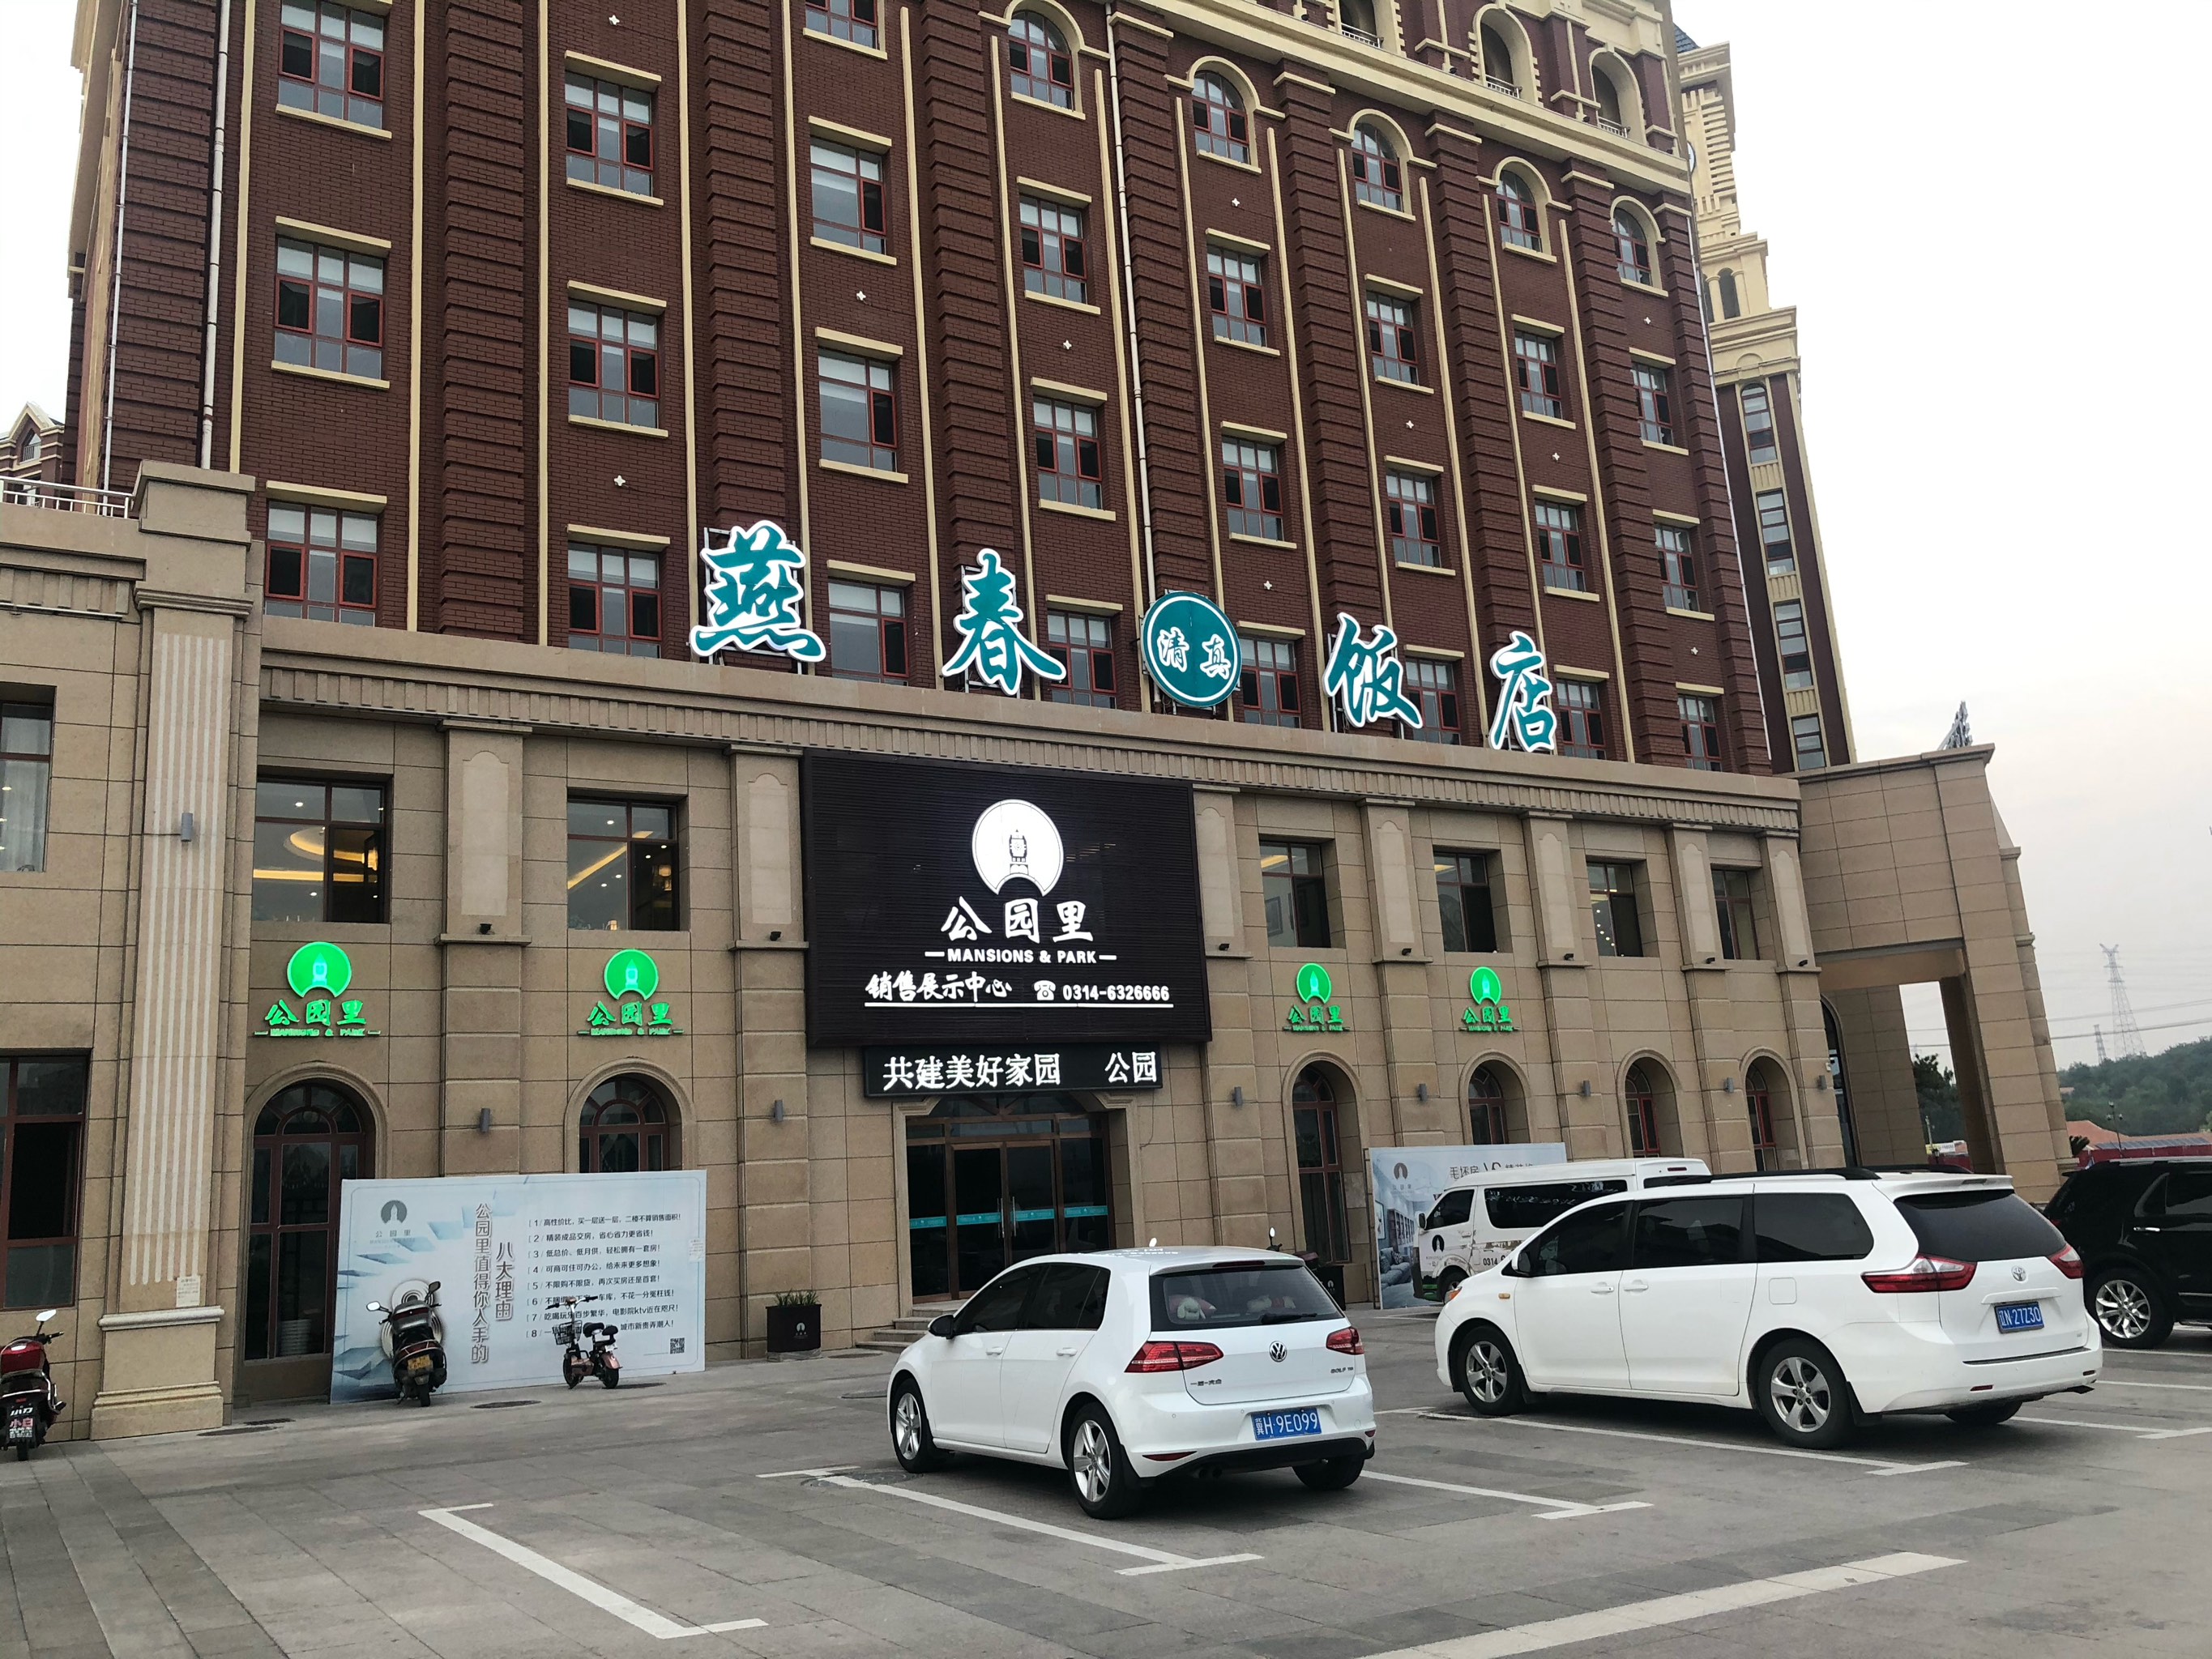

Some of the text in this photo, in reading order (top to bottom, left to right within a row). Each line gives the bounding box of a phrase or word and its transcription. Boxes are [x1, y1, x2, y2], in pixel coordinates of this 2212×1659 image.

[1158, 626, 1232, 680] 清真
[941, 897, 1094, 943] 公园里
[947, 948, 1097, 964] MANSIONS & PARK
[865, 970, 1170, 1002] 销售展示中心 0314-6326666
[265, 999, 366, 1026] 公园里
[587, 1000, 673, 1026] 公园里
[1287, 1004, 1344, 1025] 公园里
[1463, 1005, 1513, 1025] 公园里
[882, 1051, 1157, 1090] 共建美好家园 公园
[495, 1242, 514, 1320] 八大理由
